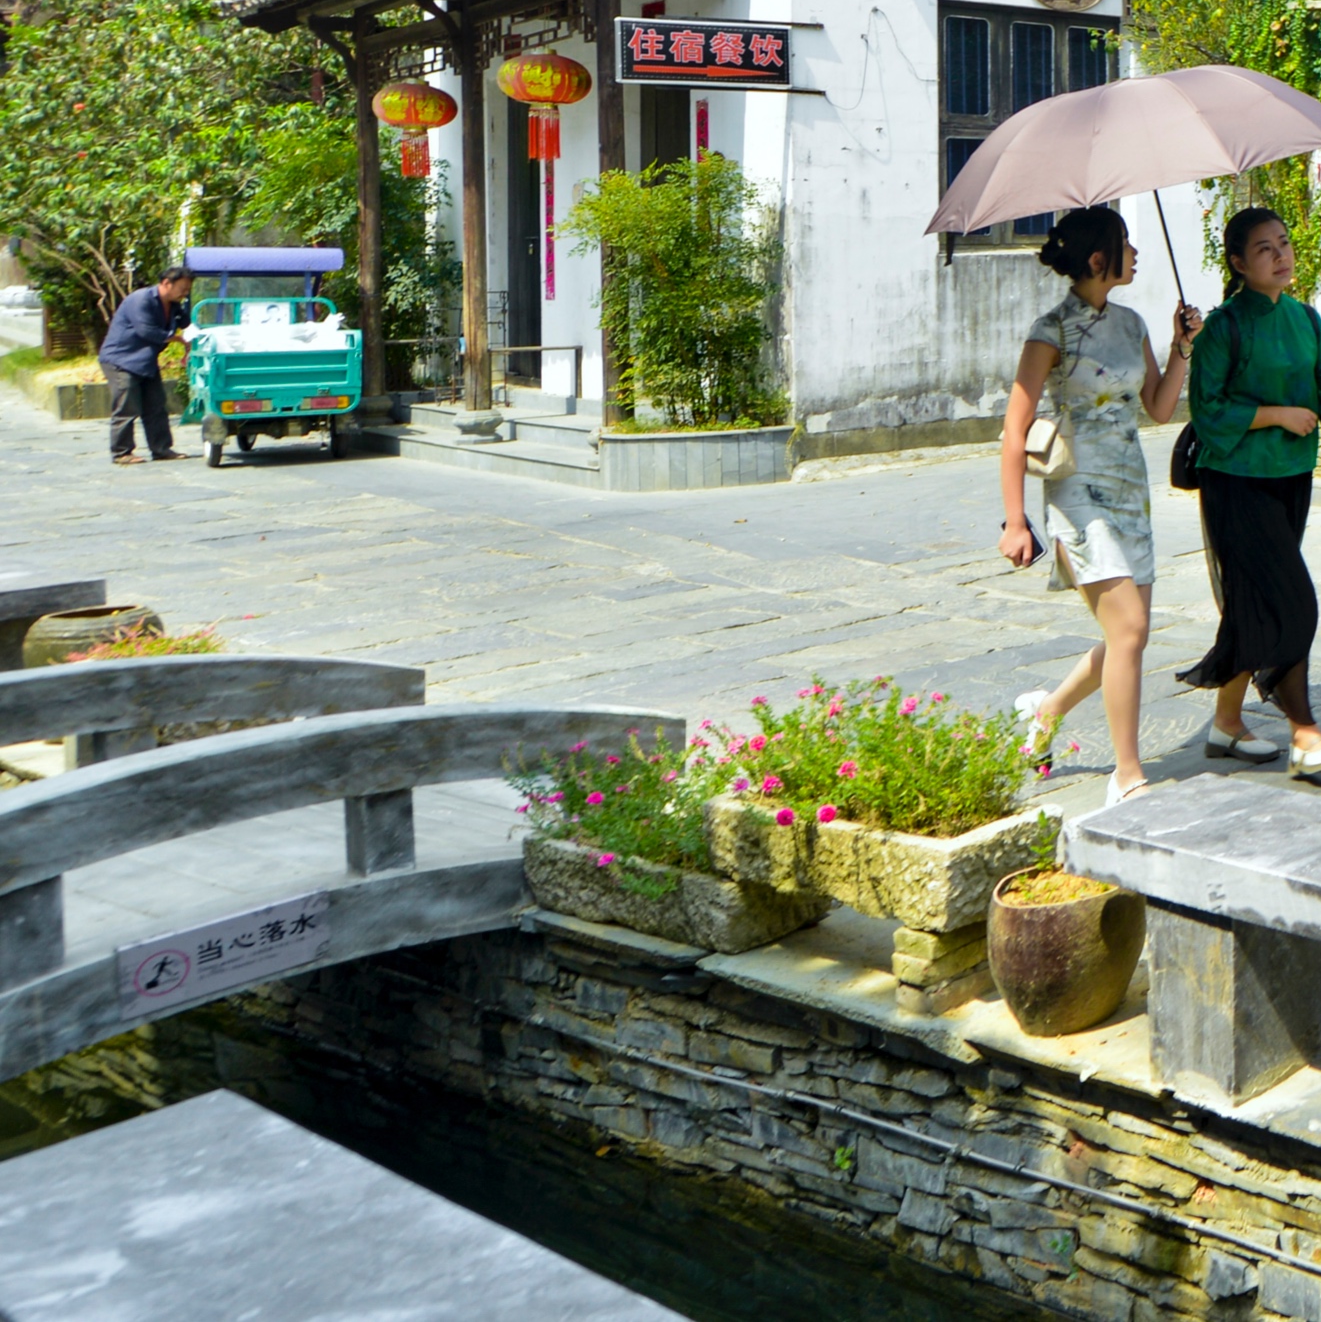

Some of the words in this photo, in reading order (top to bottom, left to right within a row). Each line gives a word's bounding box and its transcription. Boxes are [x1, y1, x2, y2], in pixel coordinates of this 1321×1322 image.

[628, 27, 784, 67] 住宿餐饮
[198, 913, 316, 965] 当心落水
